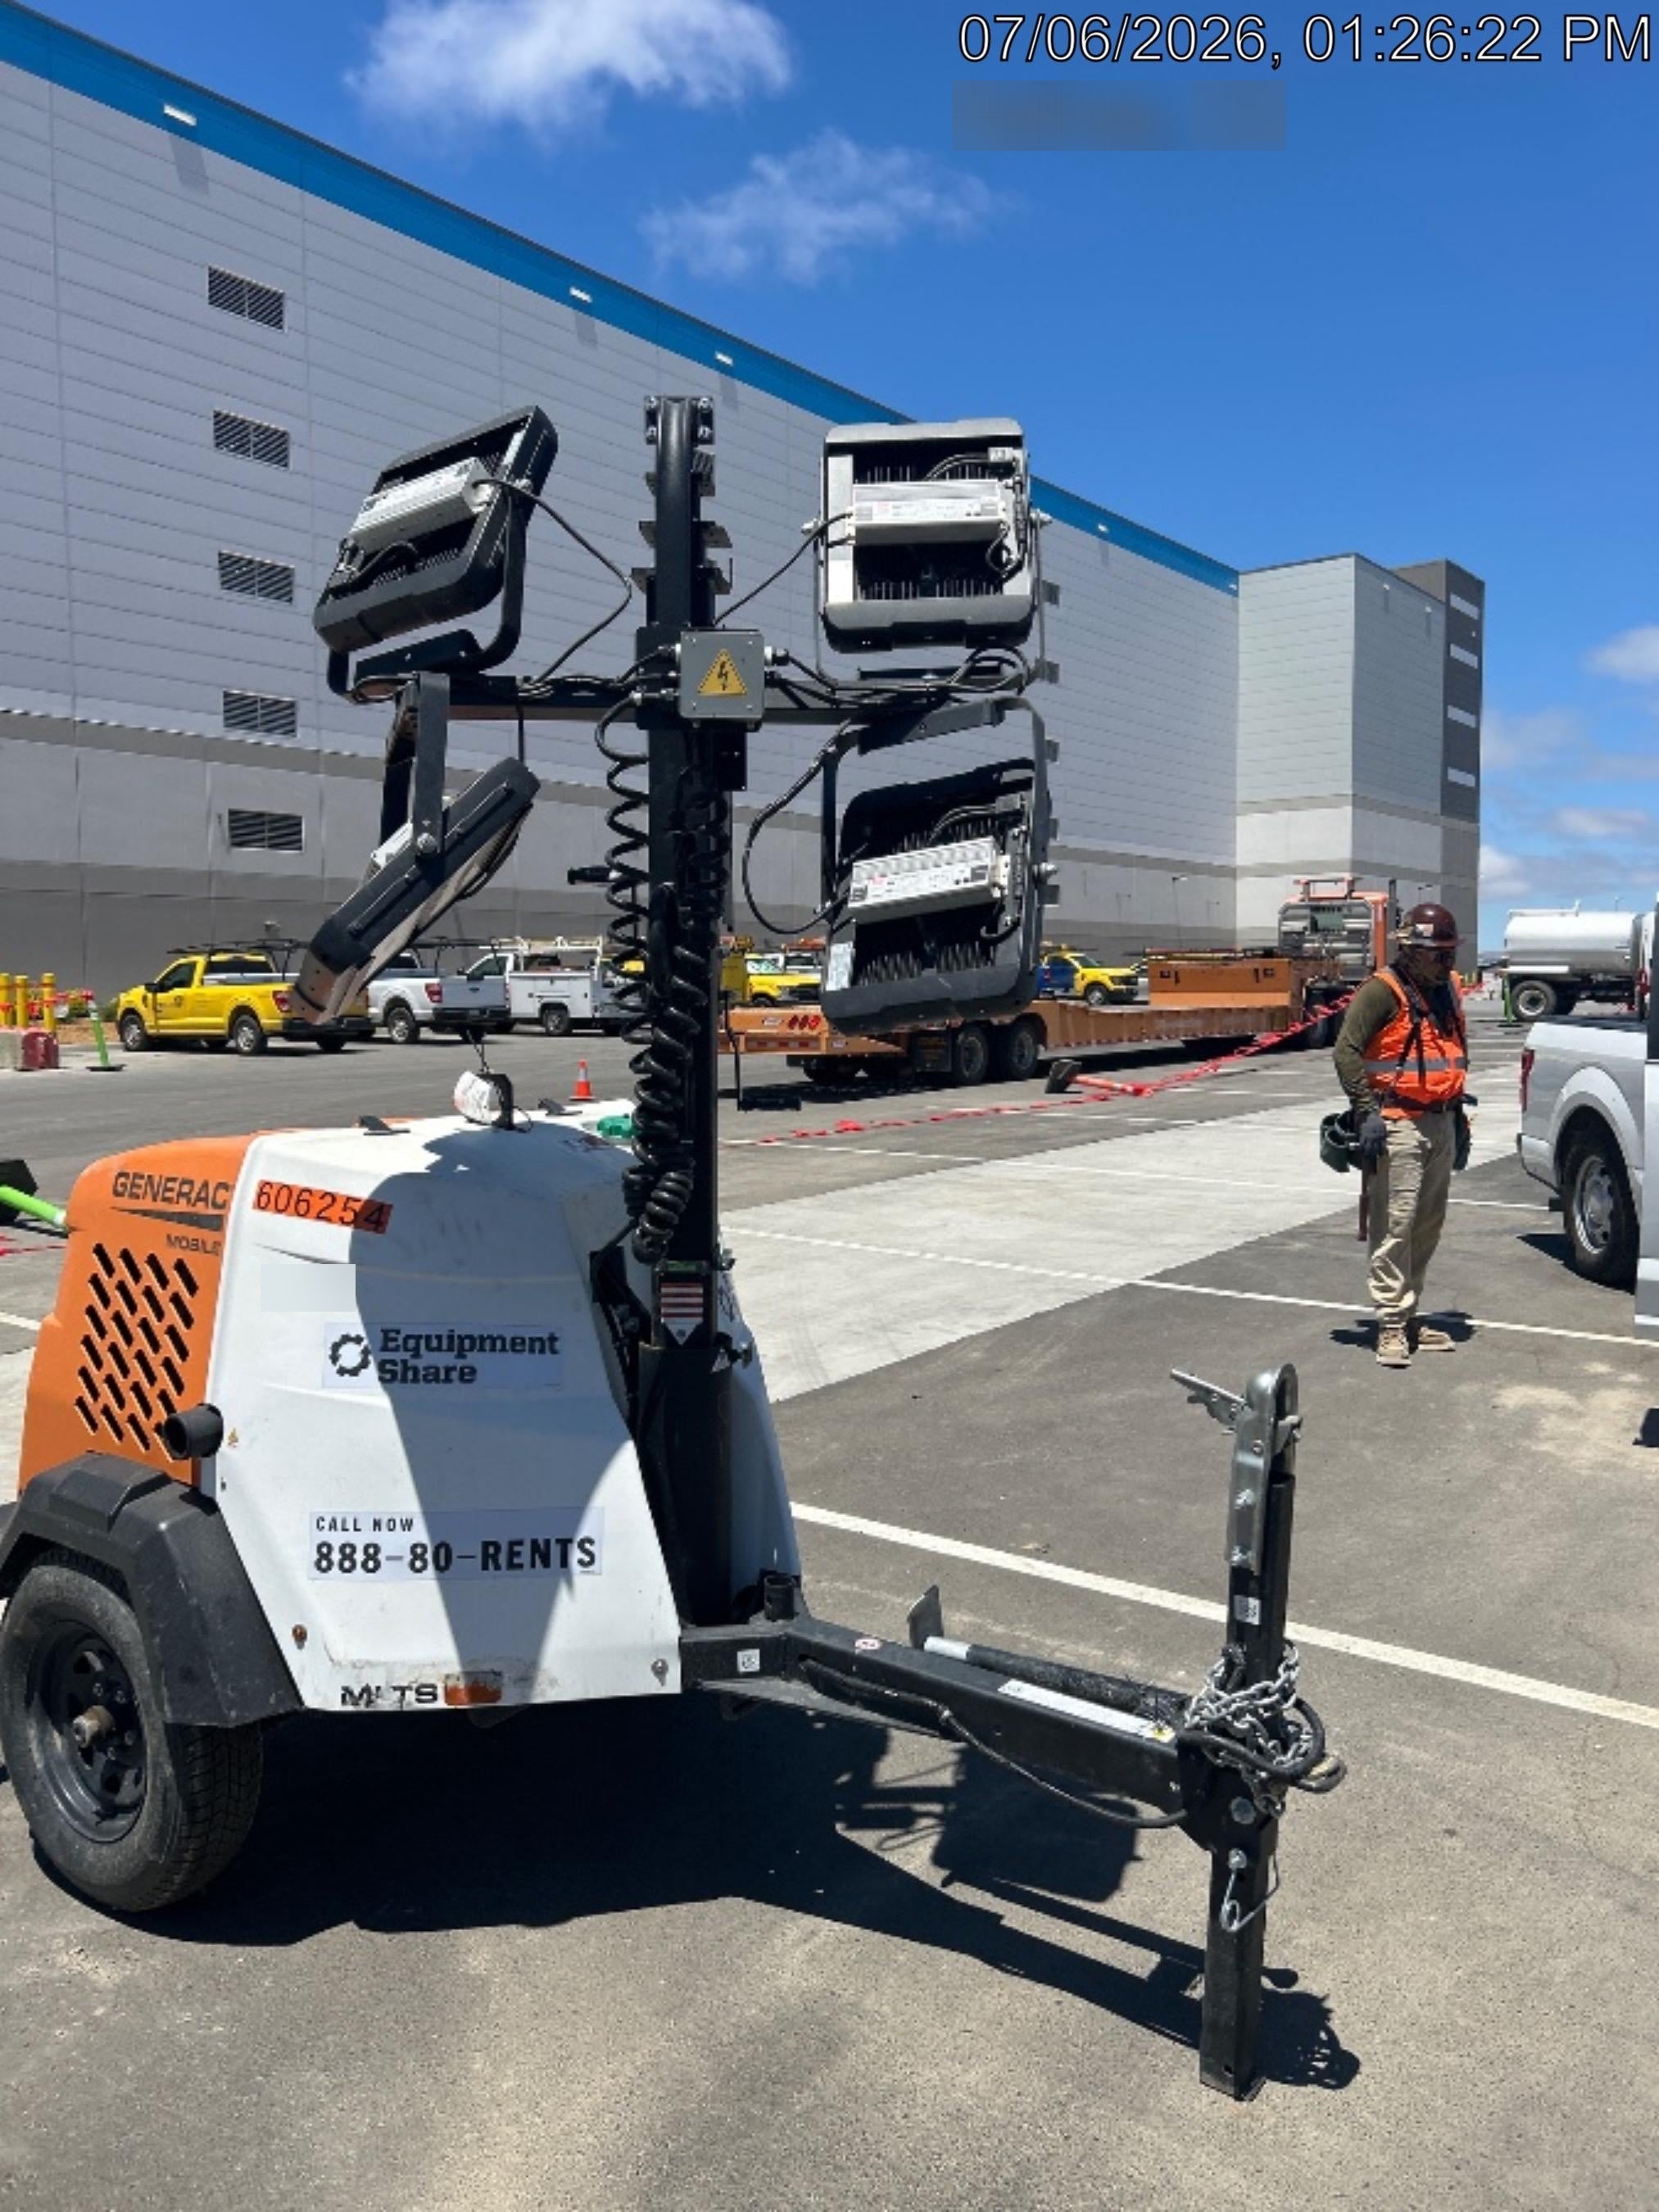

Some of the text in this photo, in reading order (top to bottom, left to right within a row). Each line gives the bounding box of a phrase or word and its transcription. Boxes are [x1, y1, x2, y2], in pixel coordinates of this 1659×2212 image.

[111, 1172, 229, 1210] GENERAC
[256, 1181, 387, 1231] 606254
[166, 1234, 222, 1256] MOBILE
[379, 1329, 559, 1359] Equipment
[378, 1359, 478, 1385] Share
[315, 1516, 415, 1532] CALL NOW
[315, 1536, 596, 1574] 888-80-RENTS
[341, 1683, 438, 1709] MTS
